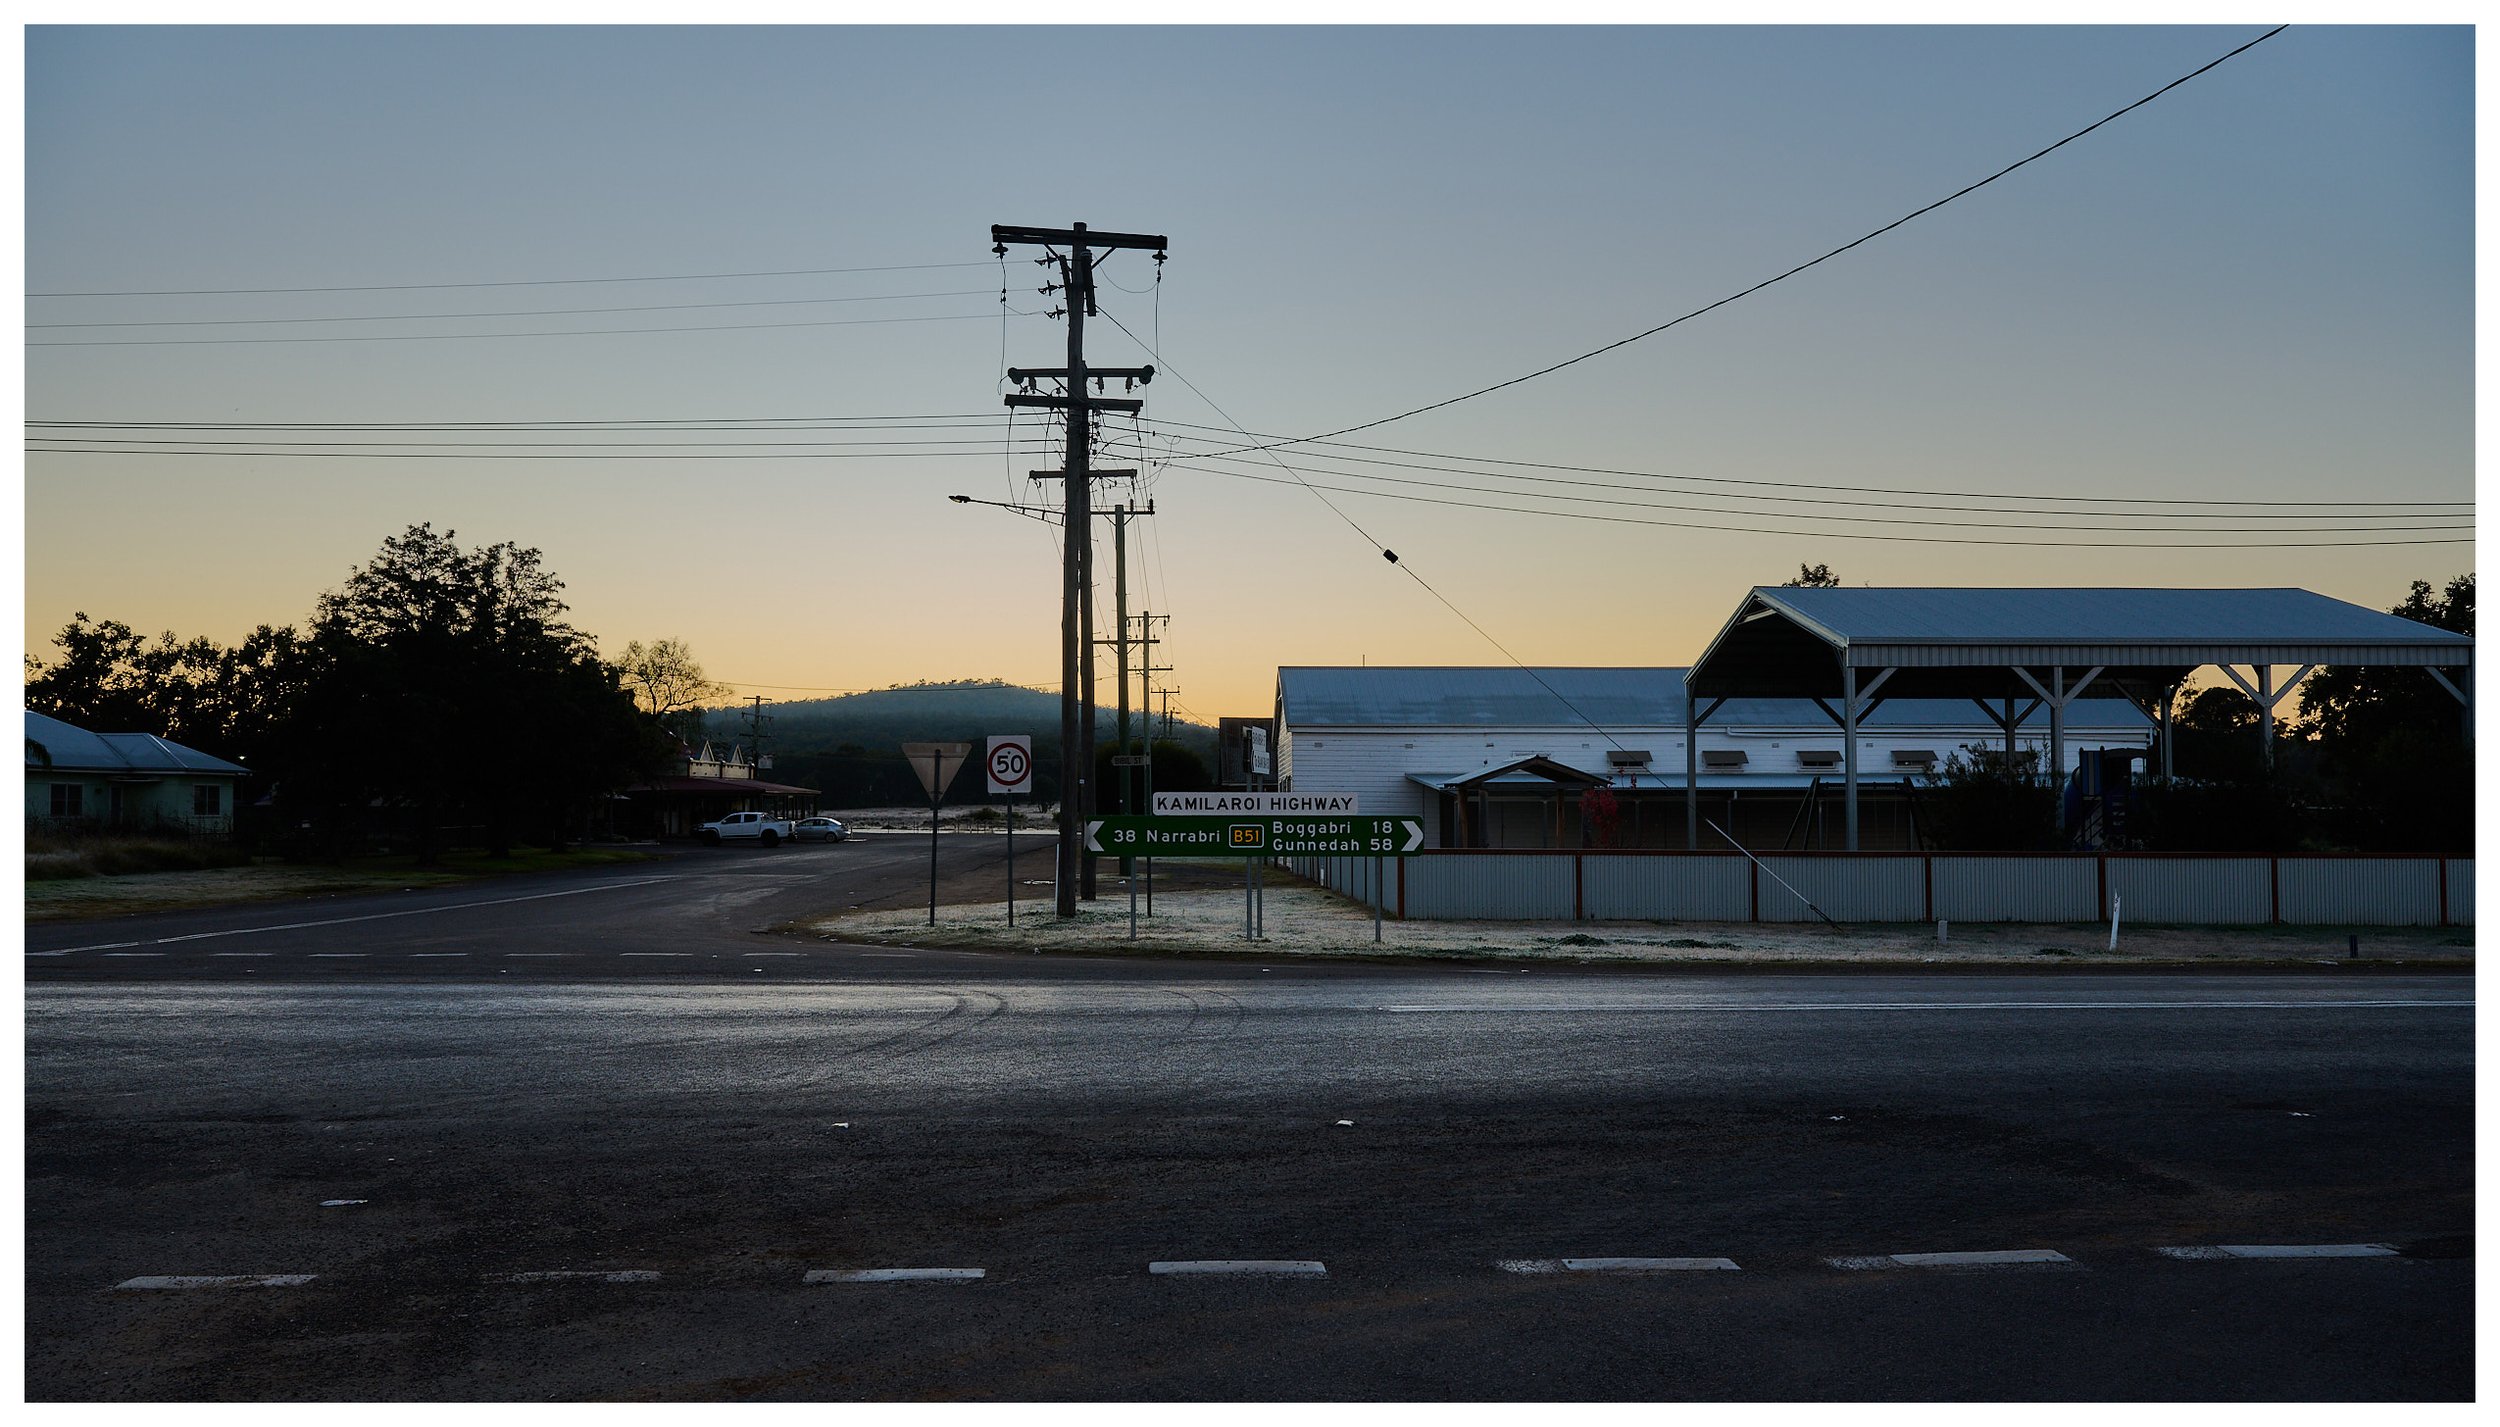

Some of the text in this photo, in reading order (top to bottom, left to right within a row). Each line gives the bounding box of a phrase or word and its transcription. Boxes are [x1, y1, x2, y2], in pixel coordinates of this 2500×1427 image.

[997, 755, 1024, 773] 50
[1157, 797, 1353, 811] KAMILAROI HIGHWAY
[1114, 829, 1221, 842] 38 Narrabri
[1273, 821, 1392, 838] Boggabri 18
[1234, 830, 1260, 843] B51
[1273, 838, 1392, 851] Gunnedah 58
